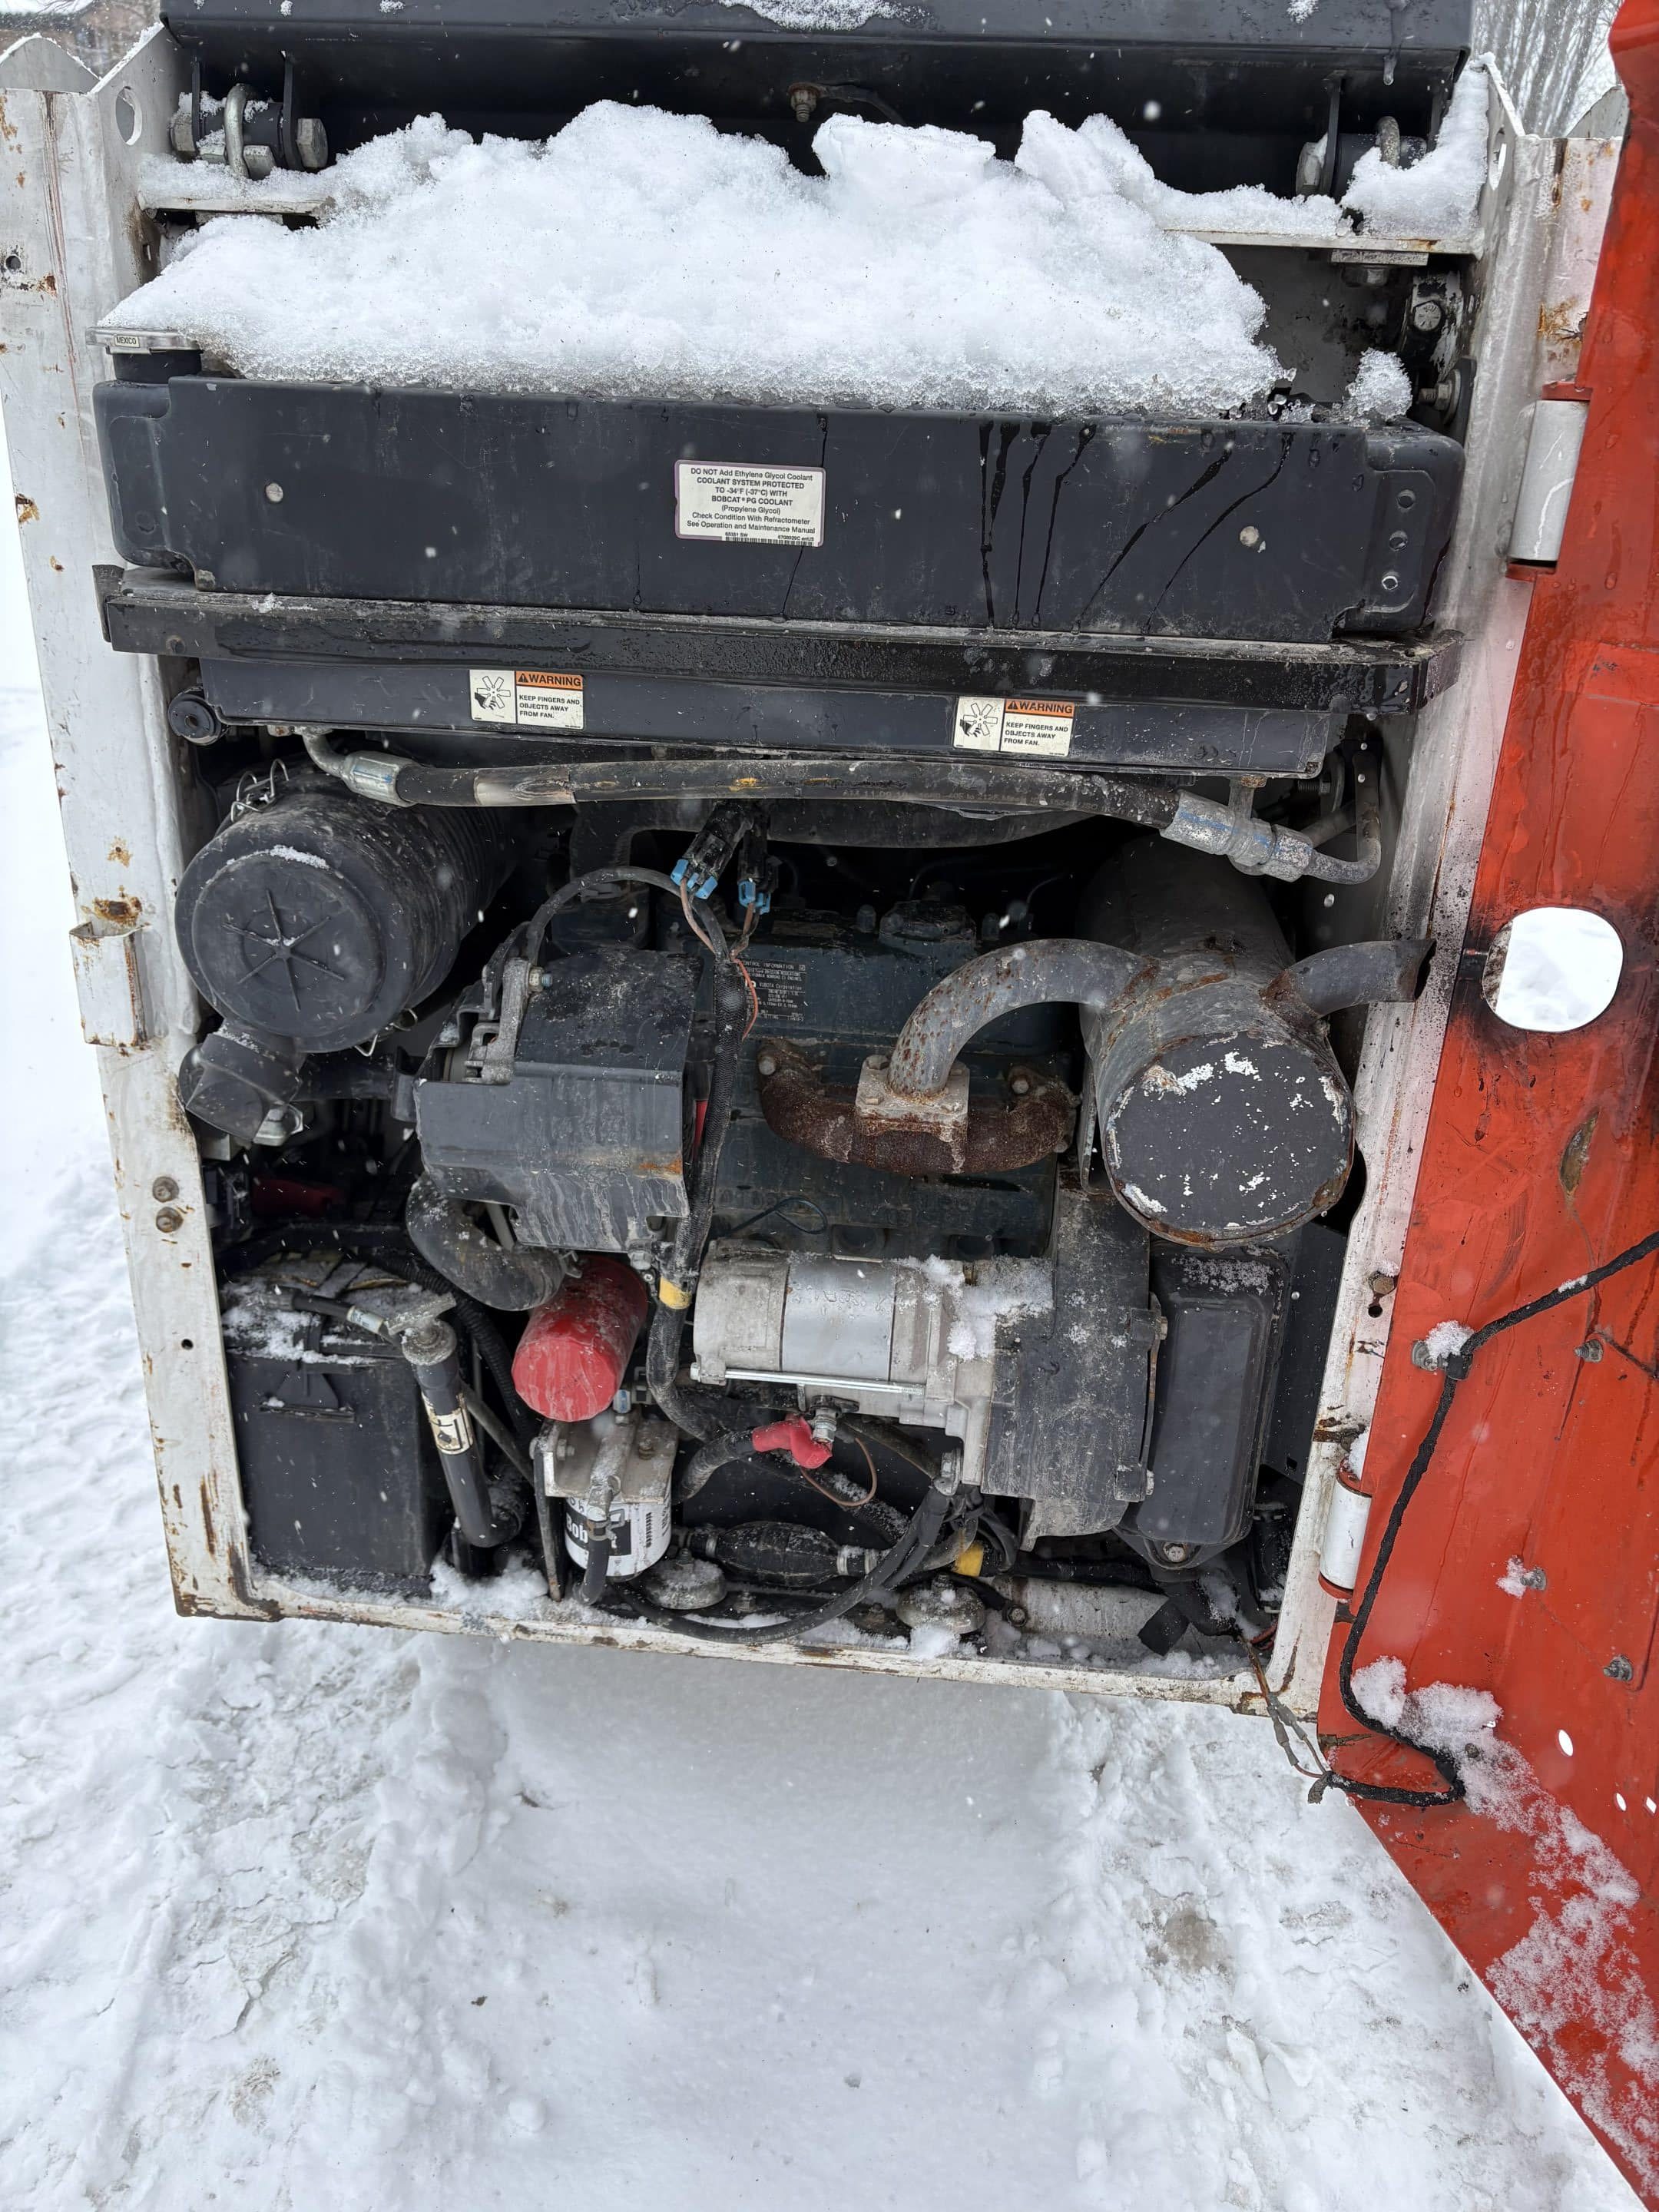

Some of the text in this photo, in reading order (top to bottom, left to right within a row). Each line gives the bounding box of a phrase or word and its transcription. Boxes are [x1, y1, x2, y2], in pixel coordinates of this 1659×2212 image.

[116, 336, 137, 345] MEXICO
[735, 470, 763, 478] Ethylene
[764, 472, 785, 481] Glycol
[786, 473, 813, 482] Coolant
[732, 478, 760, 487] SYSTEM
[762, 480, 805, 489] PROTECTED
[758, 498, 793, 506] COOLANT
[721, 505, 781, 515] (Propylene Glycol)
[763, 516, 810, 525] Refractometer
[700, 521, 733, 530] Operation
[748, 524, 790, 533] Maintenance
[791, 526, 816, 535] Manual
[528, 674, 581, 687] WARNING
[538, 695, 565, 704] FINGERS
[1019, 701, 1073, 714] WARNING
[1025, 723, 1054, 731] FINGERS
